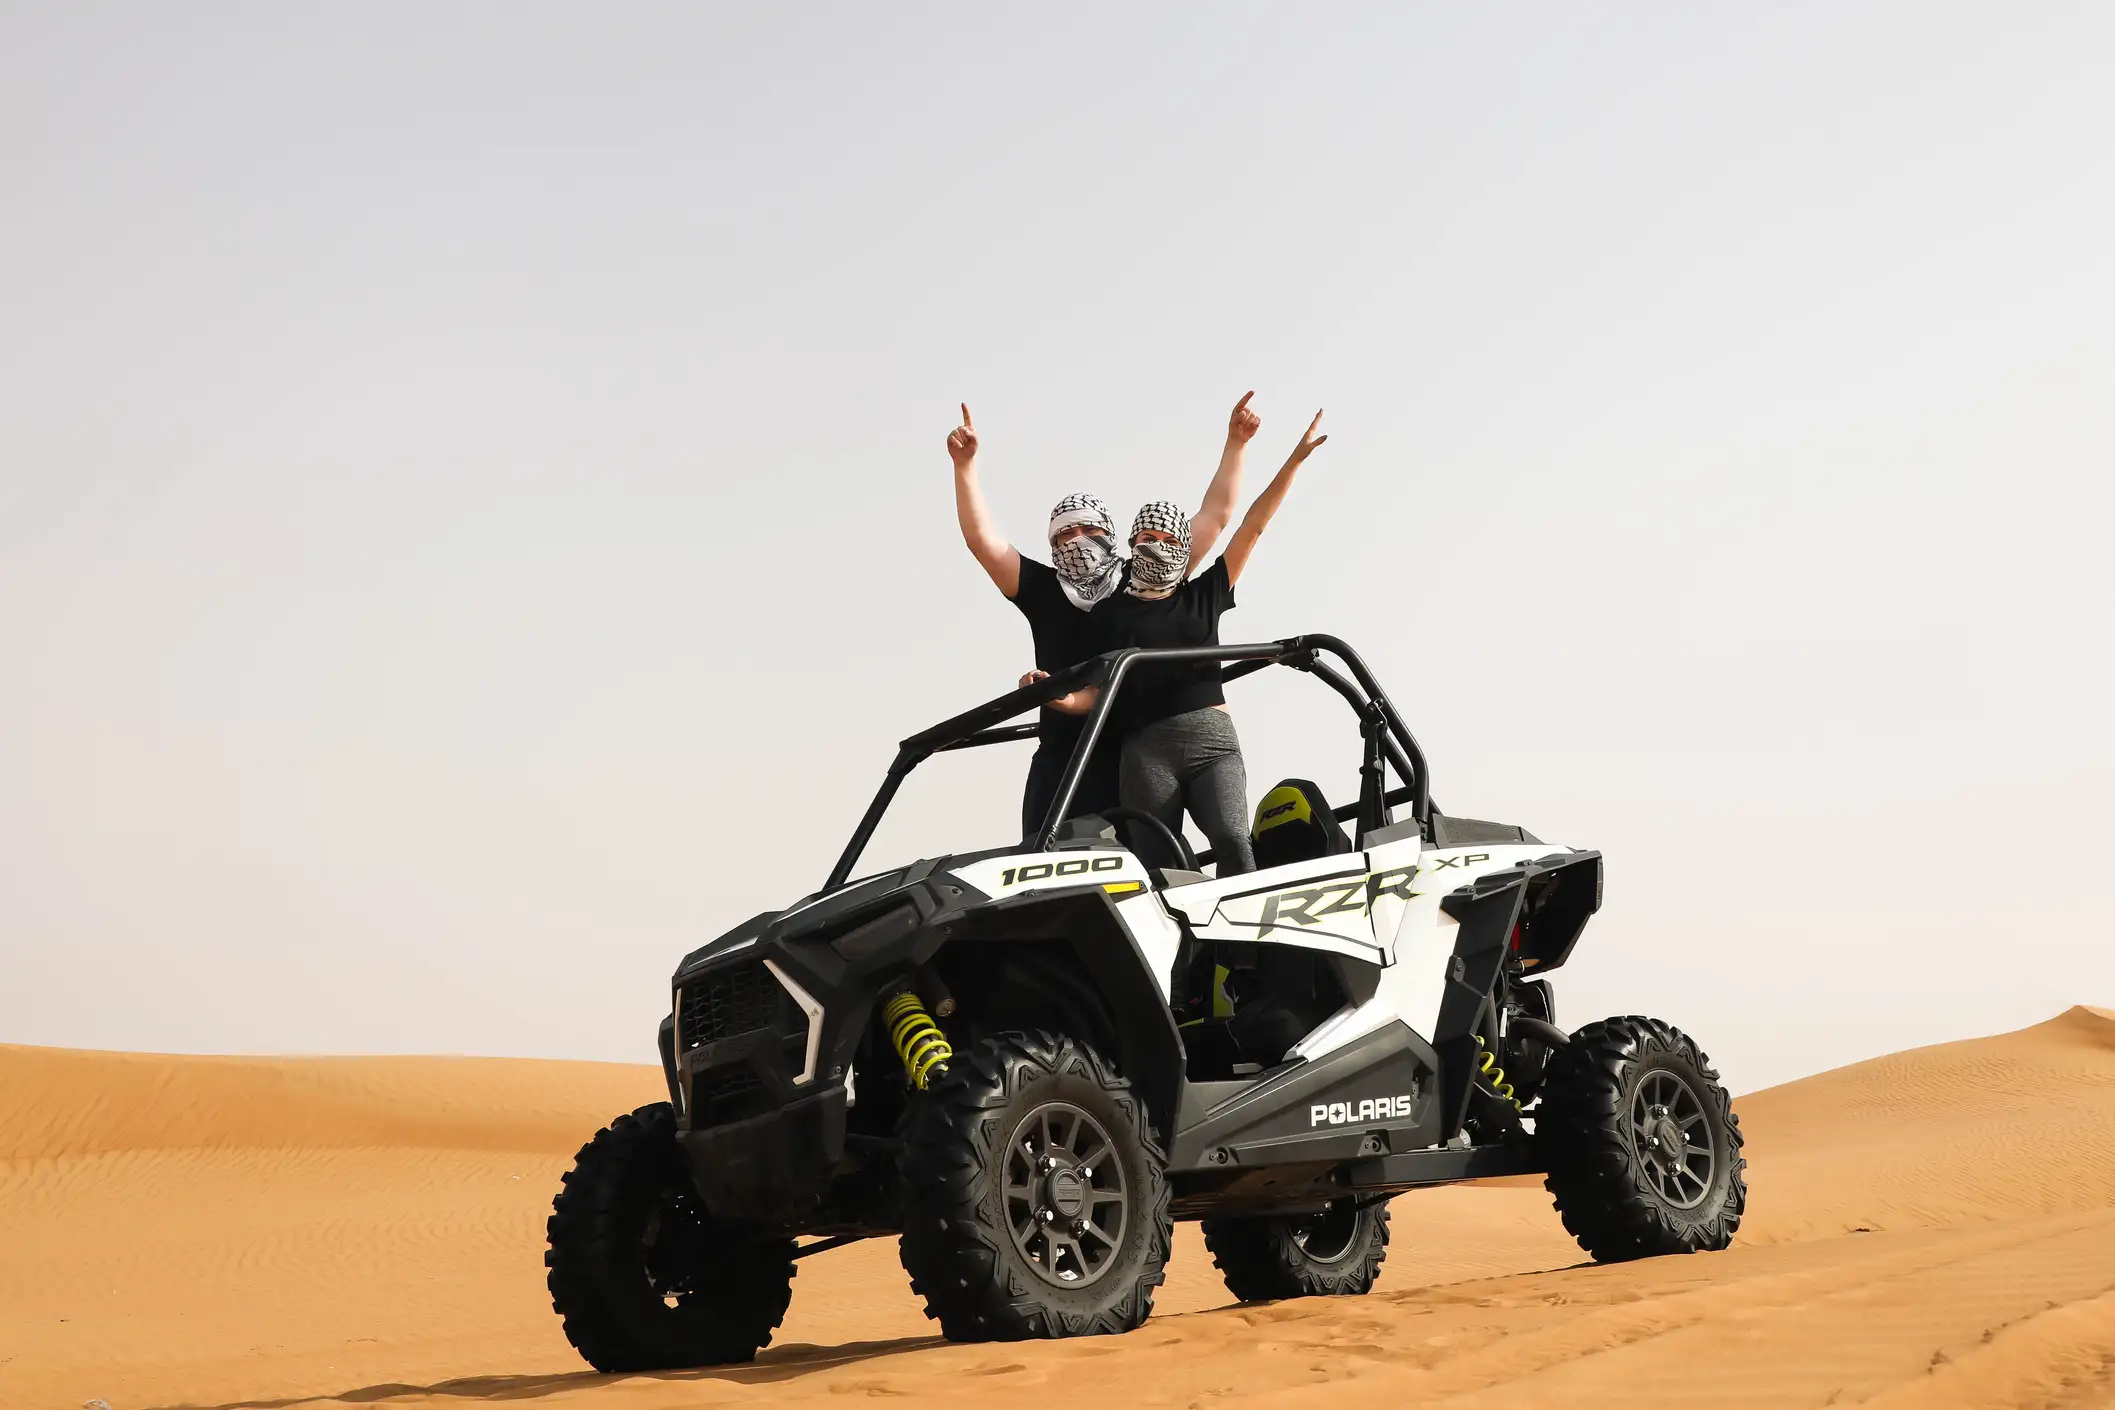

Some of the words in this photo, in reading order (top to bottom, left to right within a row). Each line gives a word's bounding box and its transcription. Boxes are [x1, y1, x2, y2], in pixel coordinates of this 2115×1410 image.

[1260, 801, 1296, 824] RZR
[1002, 856, 1123, 886] 1000
[1257, 864, 1424, 940] RZR
[1432, 853, 1490, 873] XP
[1311, 1095, 1411, 1127] POLARIS
